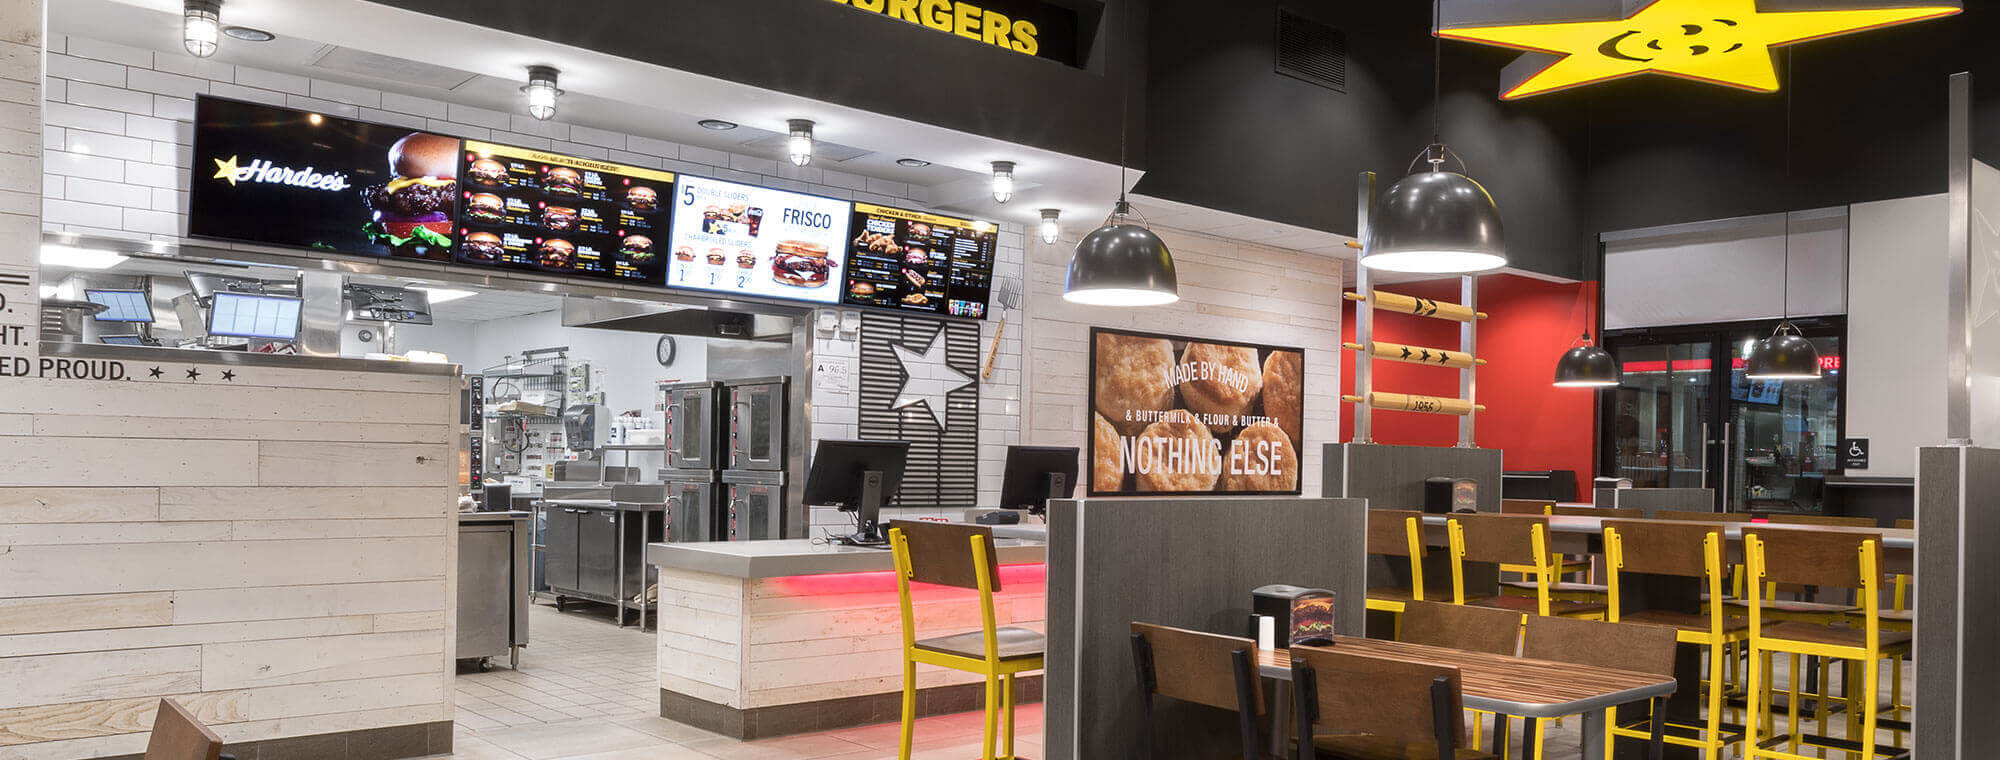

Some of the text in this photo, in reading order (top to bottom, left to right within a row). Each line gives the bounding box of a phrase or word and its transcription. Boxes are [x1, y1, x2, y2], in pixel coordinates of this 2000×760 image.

[235, 158, 351, 192] Hardee's
[783, 207, 832, 230] FRISCO
[39, 358, 131, 381] PROUD.
[1163, 361, 1249, 393] MADE BY HAND
[1125, 409, 1280, 429] & BUTTERMILK & FLOUR & BUTTER &
[1119, 435, 1282, 476] NOTHING ELSE
